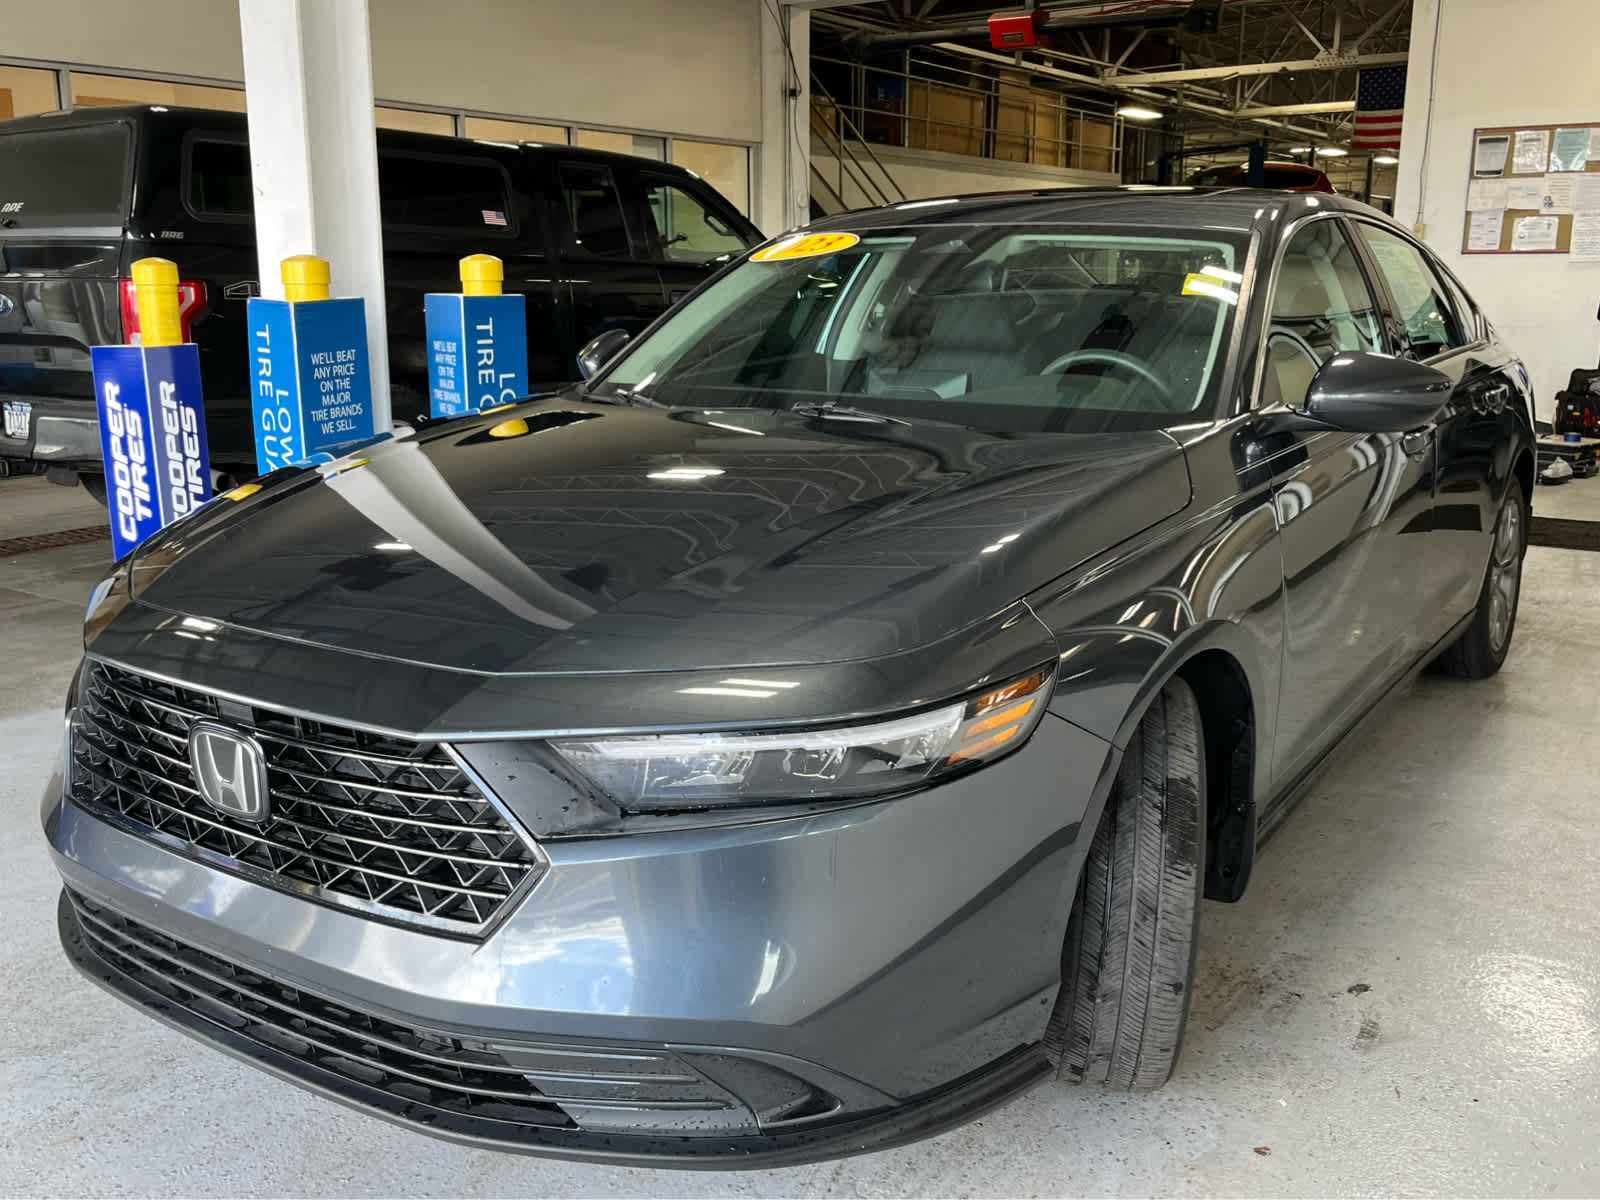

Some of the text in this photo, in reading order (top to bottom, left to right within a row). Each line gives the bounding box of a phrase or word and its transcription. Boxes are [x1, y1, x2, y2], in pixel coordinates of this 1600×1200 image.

[311, 349, 356, 366] WE'LL BEAT
[476, 317, 495, 384] TIRE
[256, 324, 273, 398] TIRE
[313, 363, 355, 380] ANY PRICE
[320, 377, 351, 393] ON THE
[322, 391, 351, 407] MAJOR
[311, 403, 363, 422] TIRE BRANDS
[321, 421, 335, 434] WE
[160, 380, 189, 521] OOPER
[104, 381, 138, 542] COOPER
[124, 407, 152, 521] TIRES
